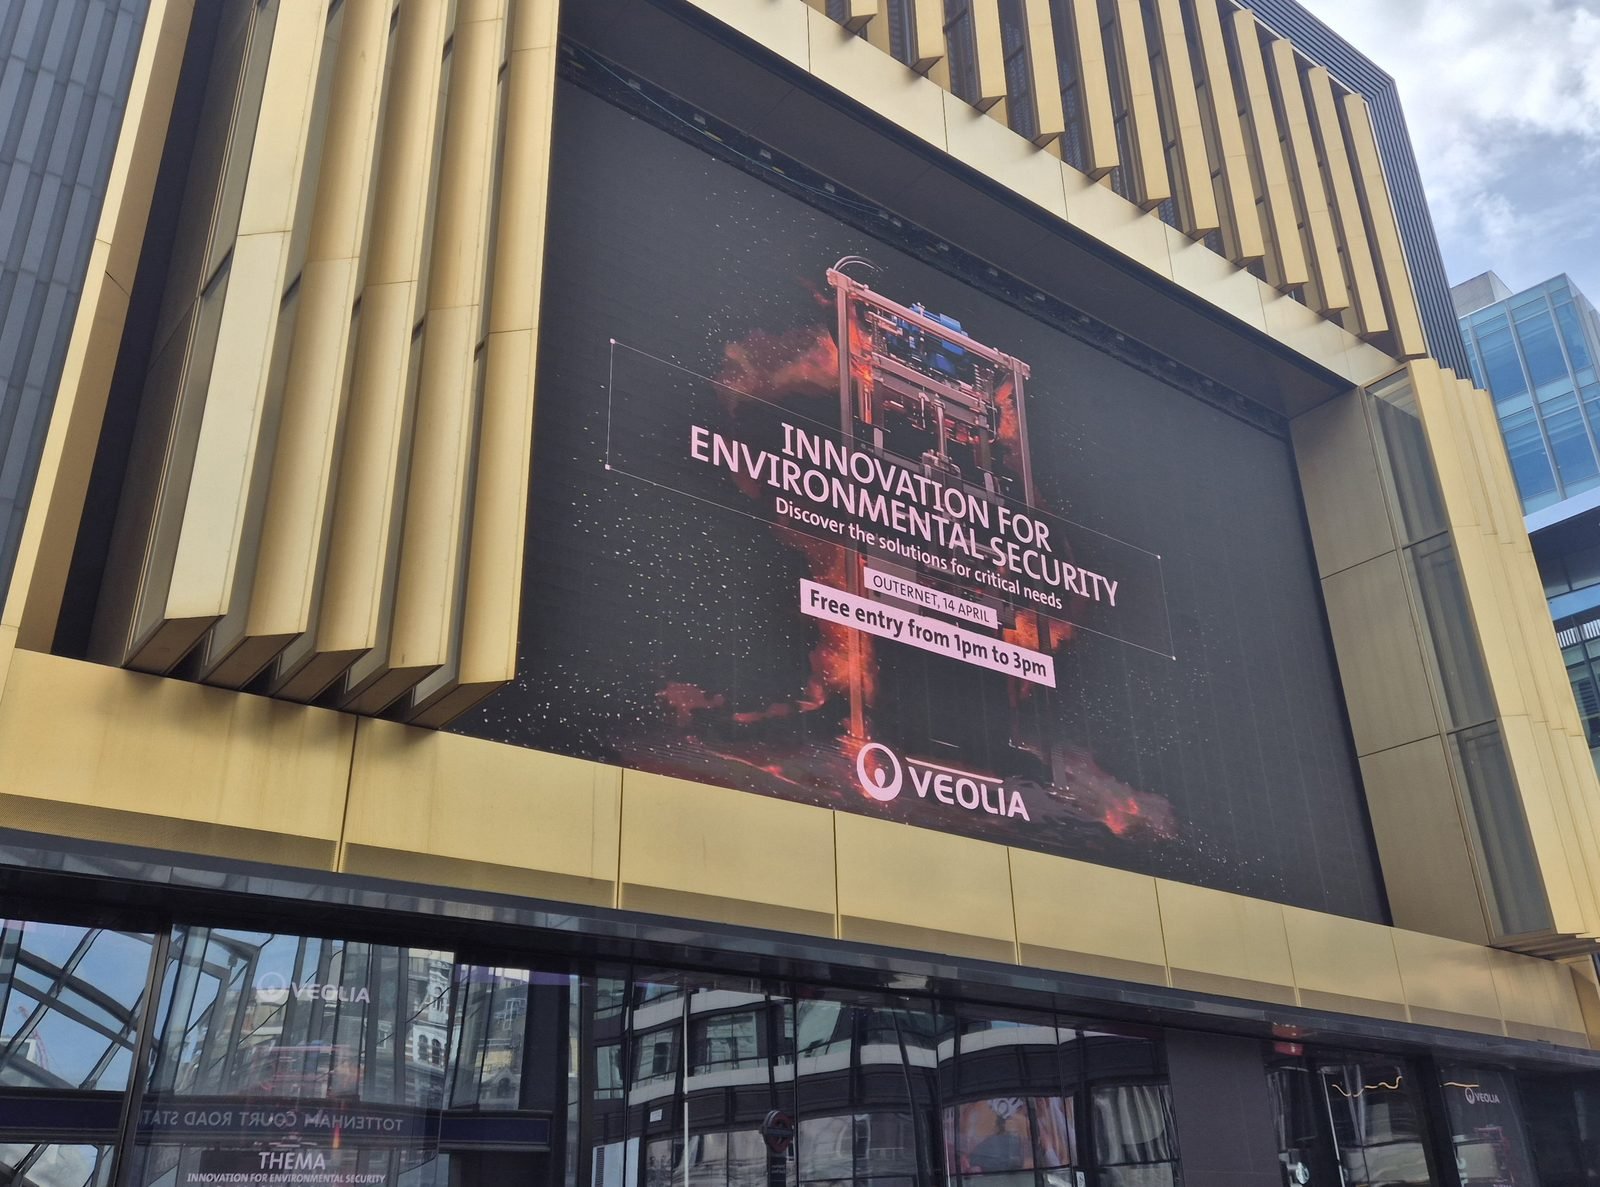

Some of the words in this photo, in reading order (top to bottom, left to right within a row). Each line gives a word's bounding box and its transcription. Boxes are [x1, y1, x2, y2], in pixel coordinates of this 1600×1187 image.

[781, 422, 989, 529] INNOVATION
[997, 506, 1052, 552] FOR
[691, 425, 985, 560] ENVIRONMENTAL
[990, 536, 1118, 607] SECURITY
[776, 497, 845, 535] Discover
[848, 522, 875, 545] the
[879, 536, 947, 571] solutions
[950, 557, 971, 578] for
[975, 569, 1020, 596] critical
[1024, 585, 1063, 610] needs
[873, 575, 941, 610] OUTERNET,
[942, 597, 955, 611] 14
[958, 602, 989, 623] APRIL
[810, 589, 850, 617] Free
[855, 607, 903, 638] entry
[908, 618, 950, 648] from
[953, 634, 988, 659] 1pm
[991, 645, 1009, 665] to
[1013, 652, 1047, 677] 3pm
[908, 766, 1031, 822] VEOLIA
[291, 982, 371, 1004] VEOLIA
[1474, 1092, 1501, 1104] VEOLIA
[186, 1173, 249, 1183] INNOVATION
[250, 1173, 268, 1183] FOR
[269, 1173, 344, 1184] ENVIRONMENTAL
[345, 1174, 386, 1184] SECURITY
[258, 1151, 326, 1170] THEMA
